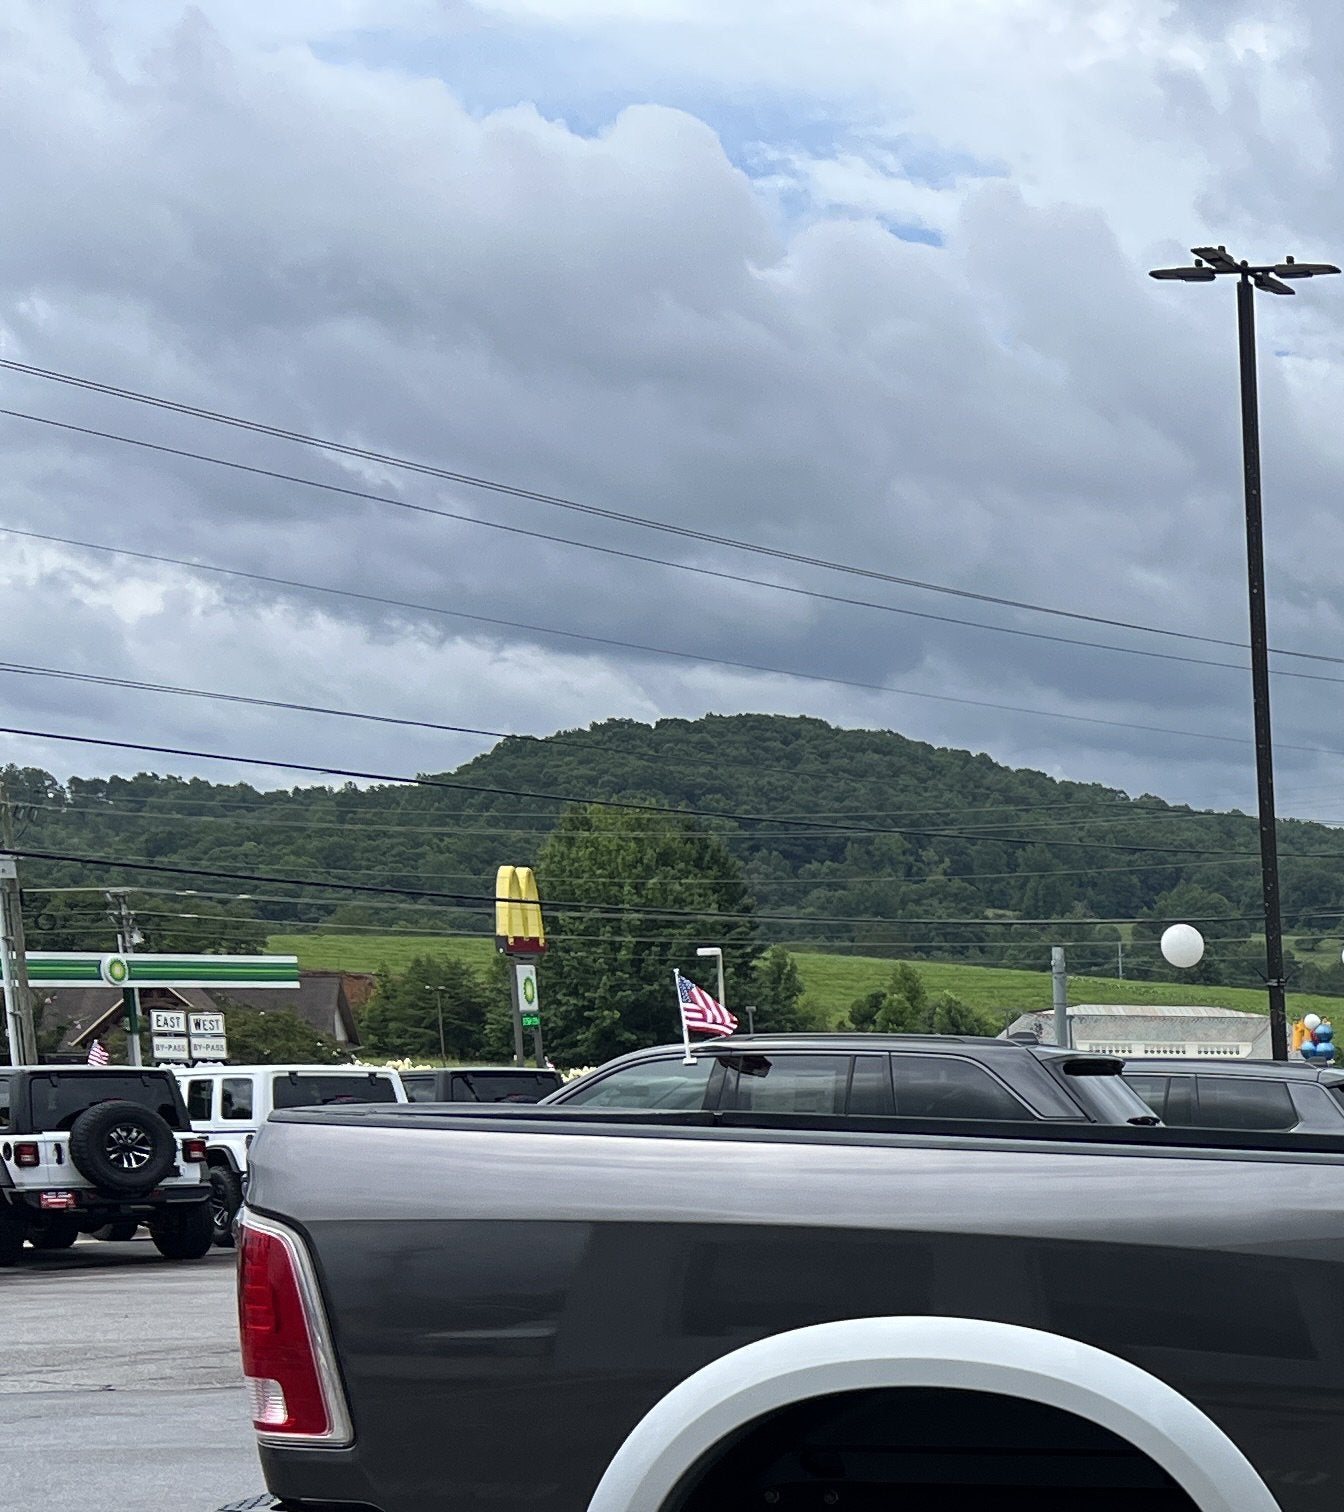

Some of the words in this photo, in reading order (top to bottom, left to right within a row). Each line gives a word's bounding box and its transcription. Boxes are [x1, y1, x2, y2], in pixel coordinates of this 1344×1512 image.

[155, 1014, 181, 1029] EAST
[193, 1018, 220, 1031] WEST
[155, 1043, 186, 1052] BY-PASS
[193, 1043, 225, 1052] BY-PASS
